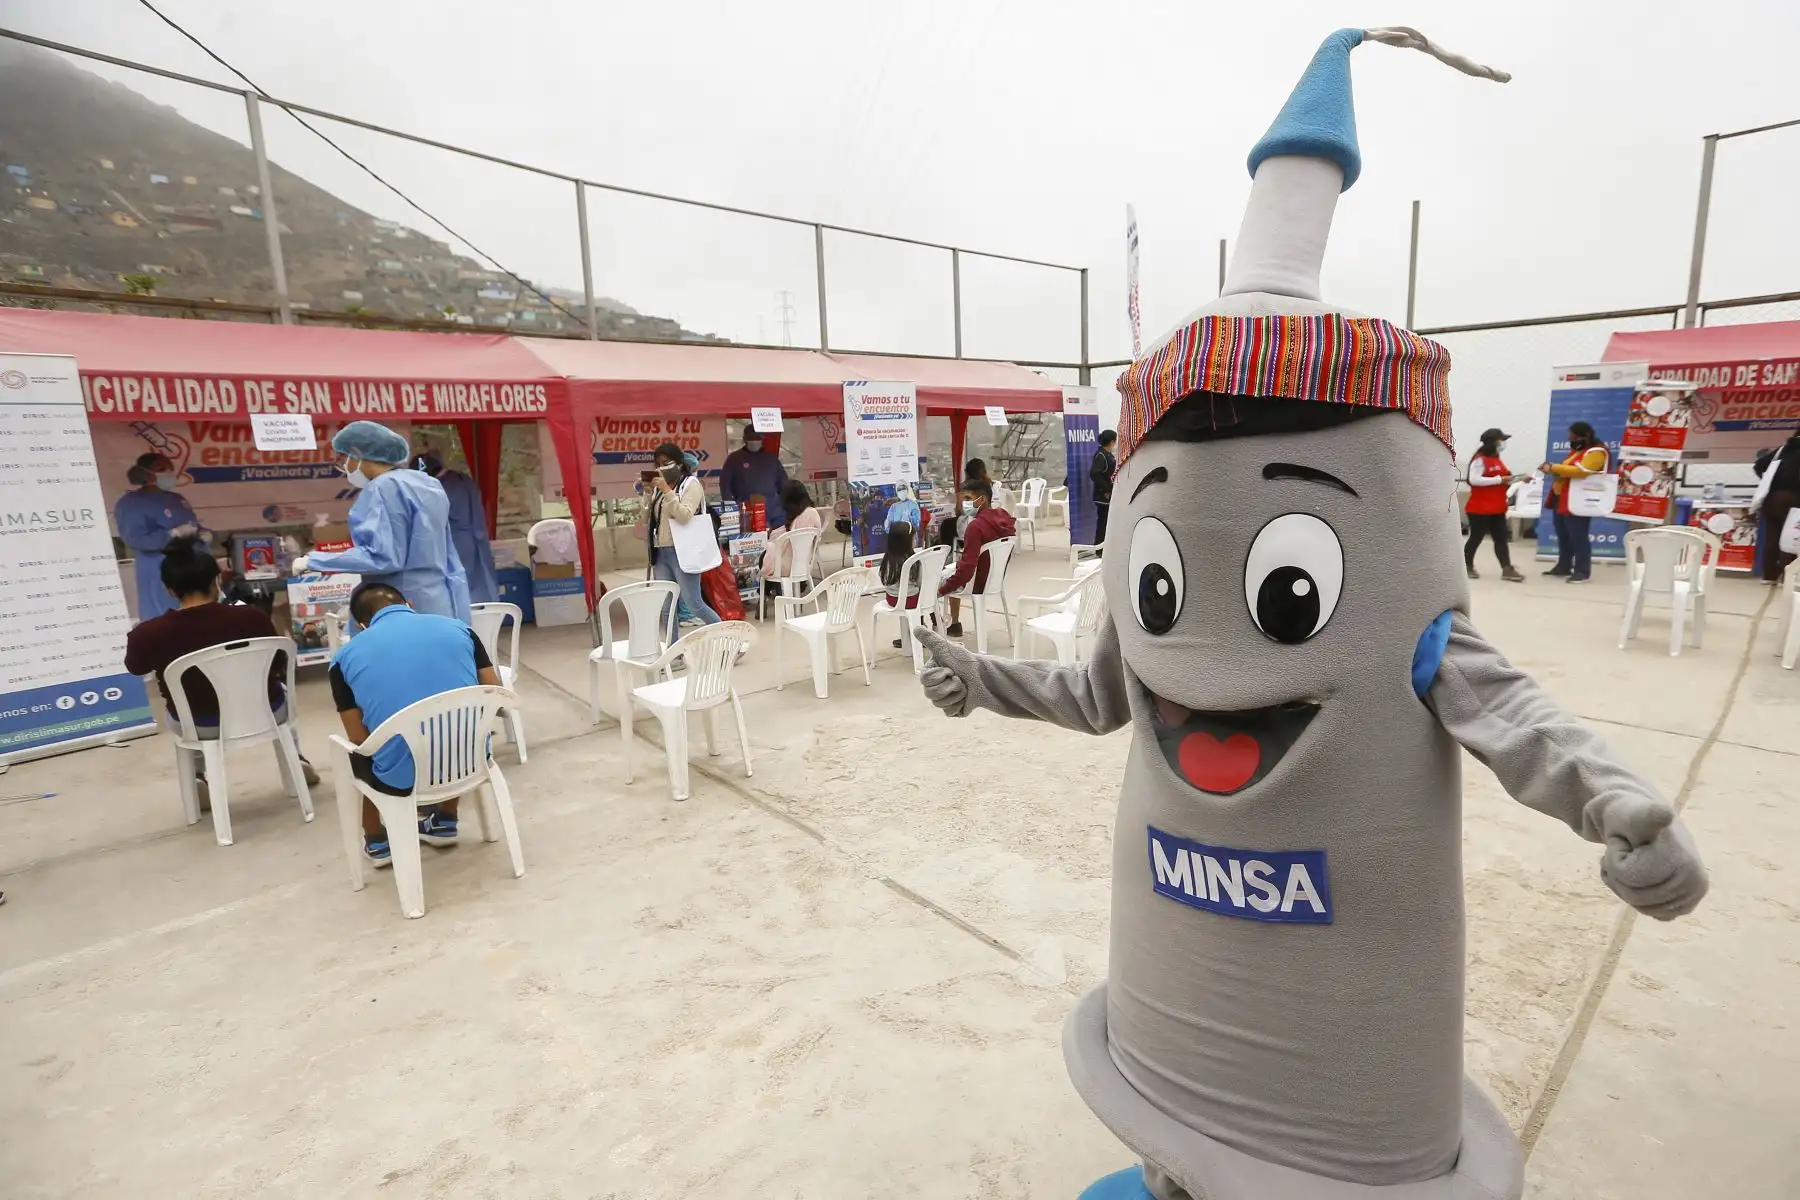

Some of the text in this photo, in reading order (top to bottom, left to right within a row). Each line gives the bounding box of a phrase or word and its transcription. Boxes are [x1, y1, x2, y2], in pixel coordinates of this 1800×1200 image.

[1735, 365, 1759, 387] DE
[244, 380, 278, 414] DE
[283, 381, 332, 414] SAN
[338, 382, 397, 414] JUAN
[401, 383, 429, 413] DE
[432, 383, 547, 412] MIRAFLORES
[861, 394, 910, 405] Vamos a tu
[864, 404, 909, 413] encuentro
[595, 416, 702, 434] Vamos a tu
[1068, 429, 1096, 443] MINSA
[201, 445, 340, 465] encuent
[624, 452, 656, 464] ¡Vacúna
[240, 466, 333, 481] ¡Vacúnate ya!
[31, 703, 52, 713] en:
[1152, 837, 1327, 913] MINSA
